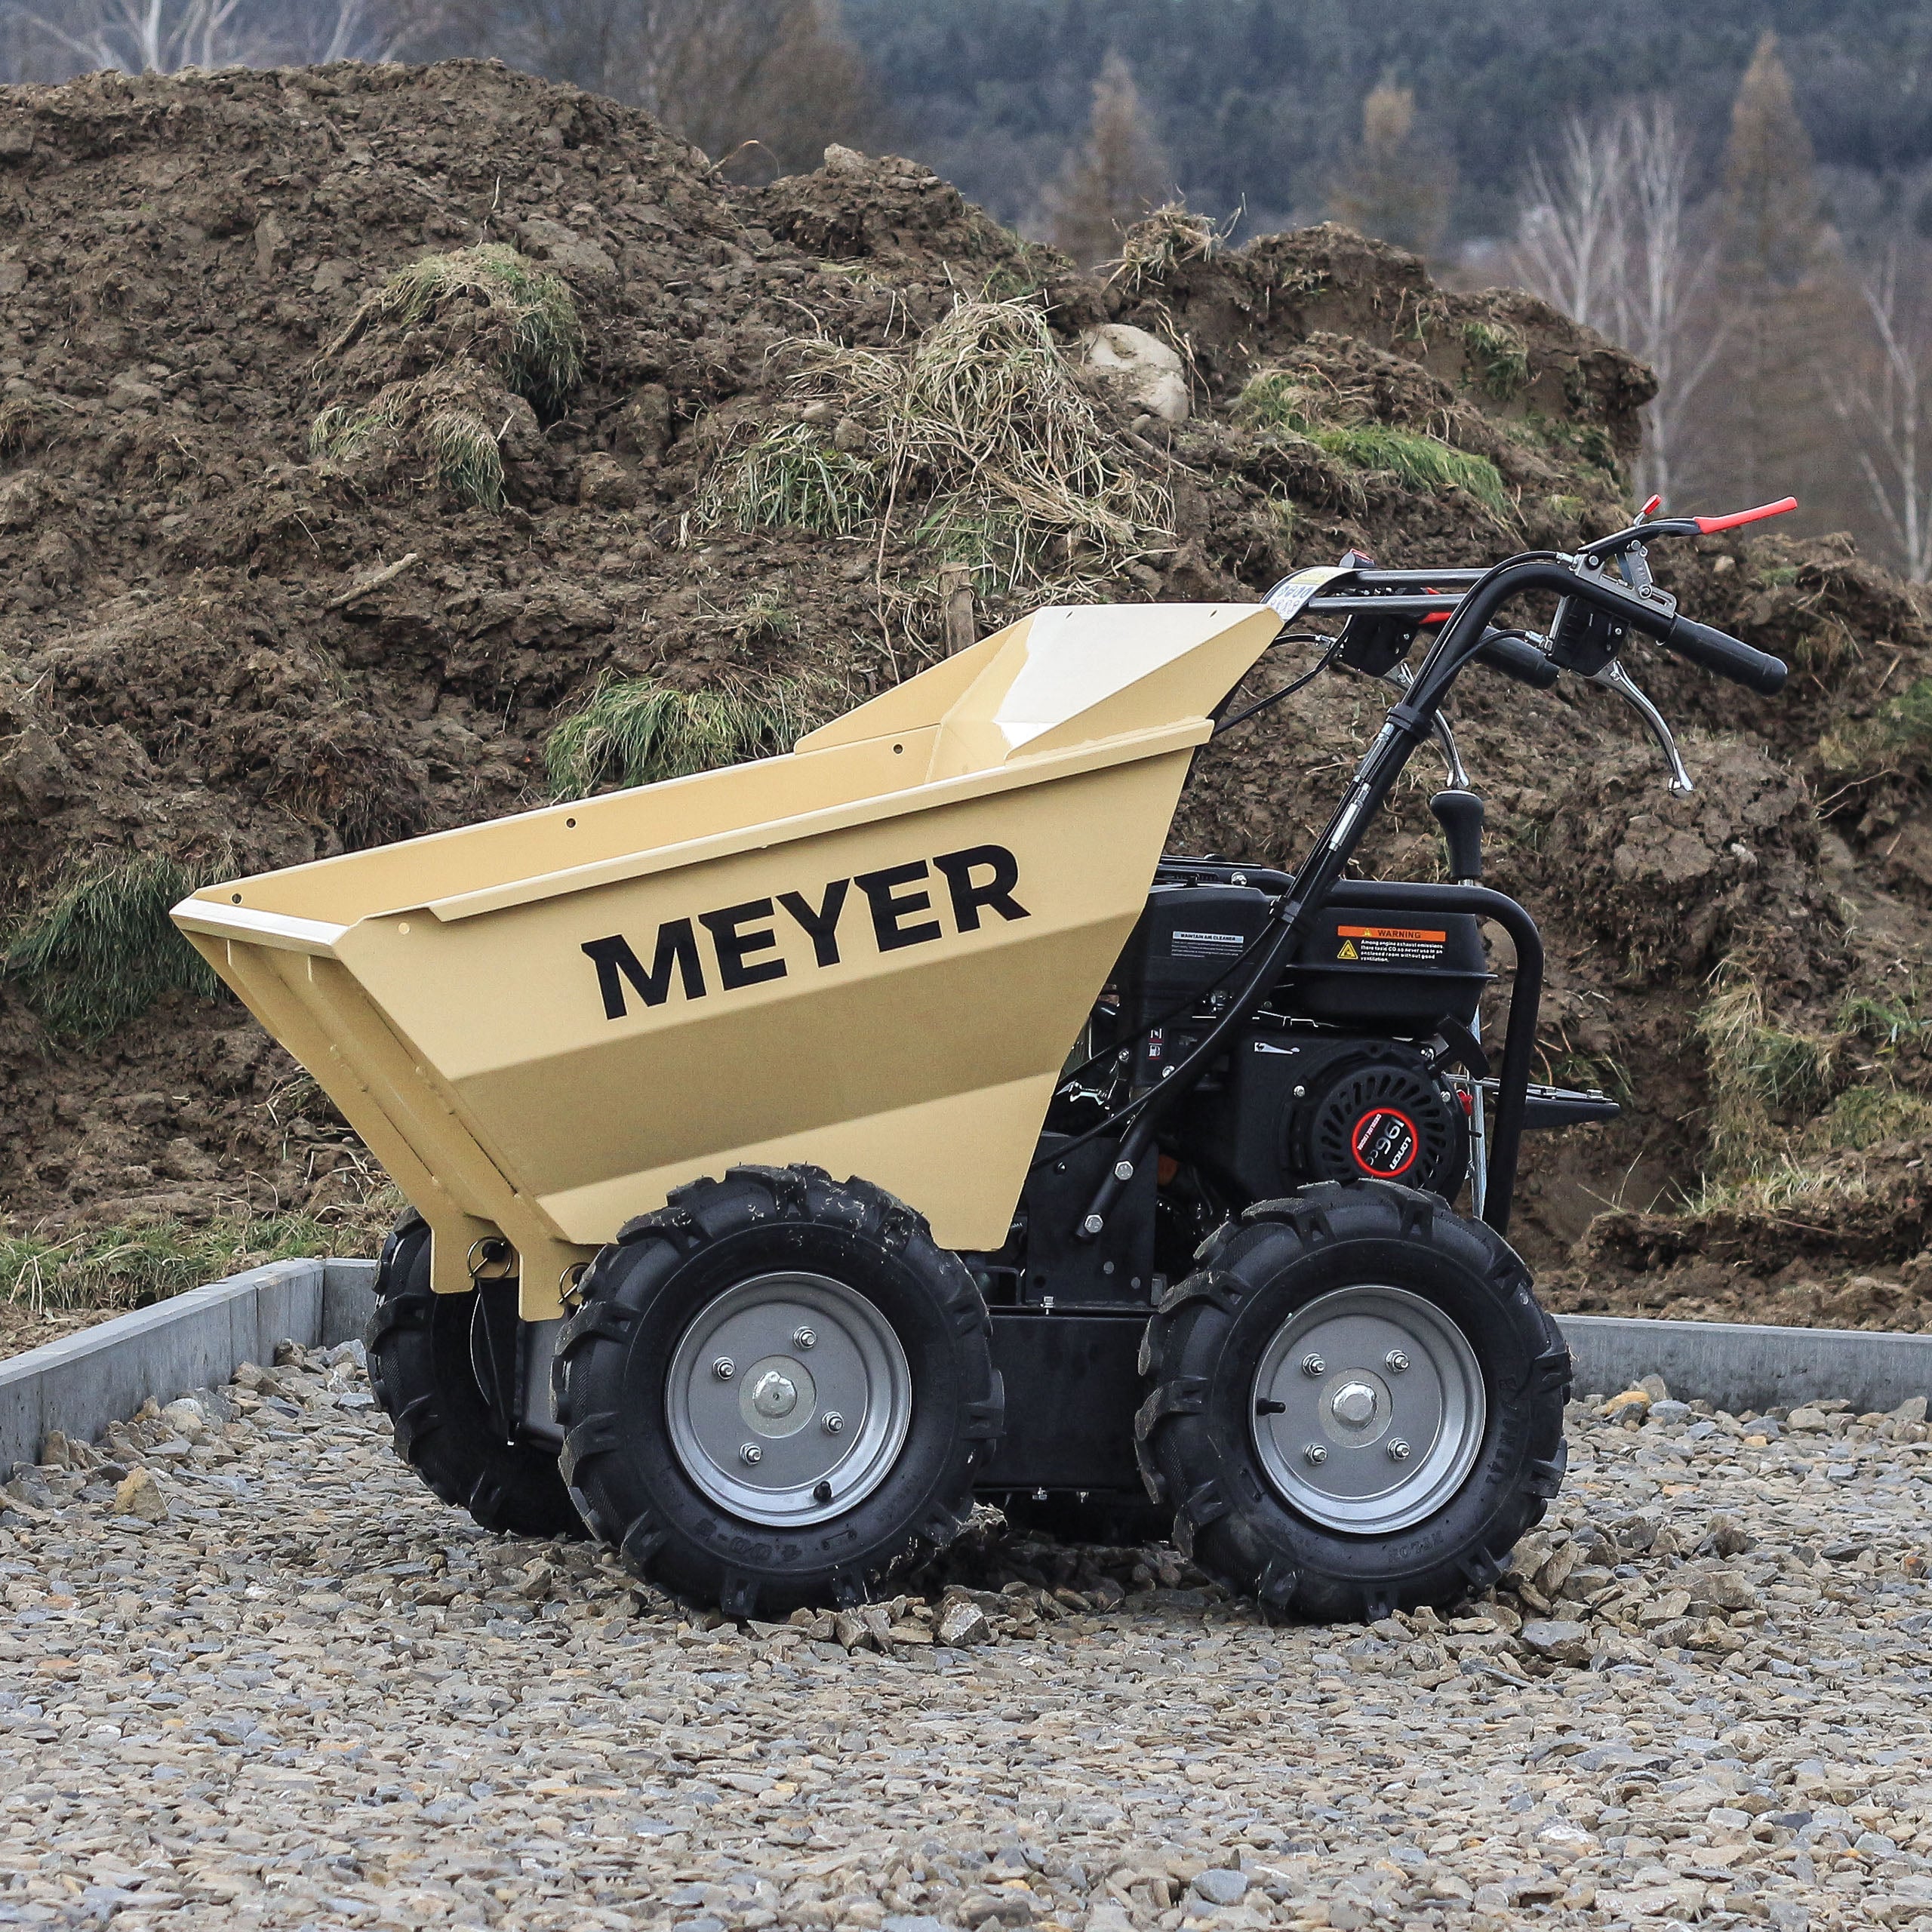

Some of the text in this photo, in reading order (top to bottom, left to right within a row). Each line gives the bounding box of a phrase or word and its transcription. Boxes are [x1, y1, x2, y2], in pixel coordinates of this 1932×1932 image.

[580, 844, 1032, 1021] MEYER
[1377, 929, 1421, 939] WARNING
[1365, 1116, 1404, 1166] 196cc
